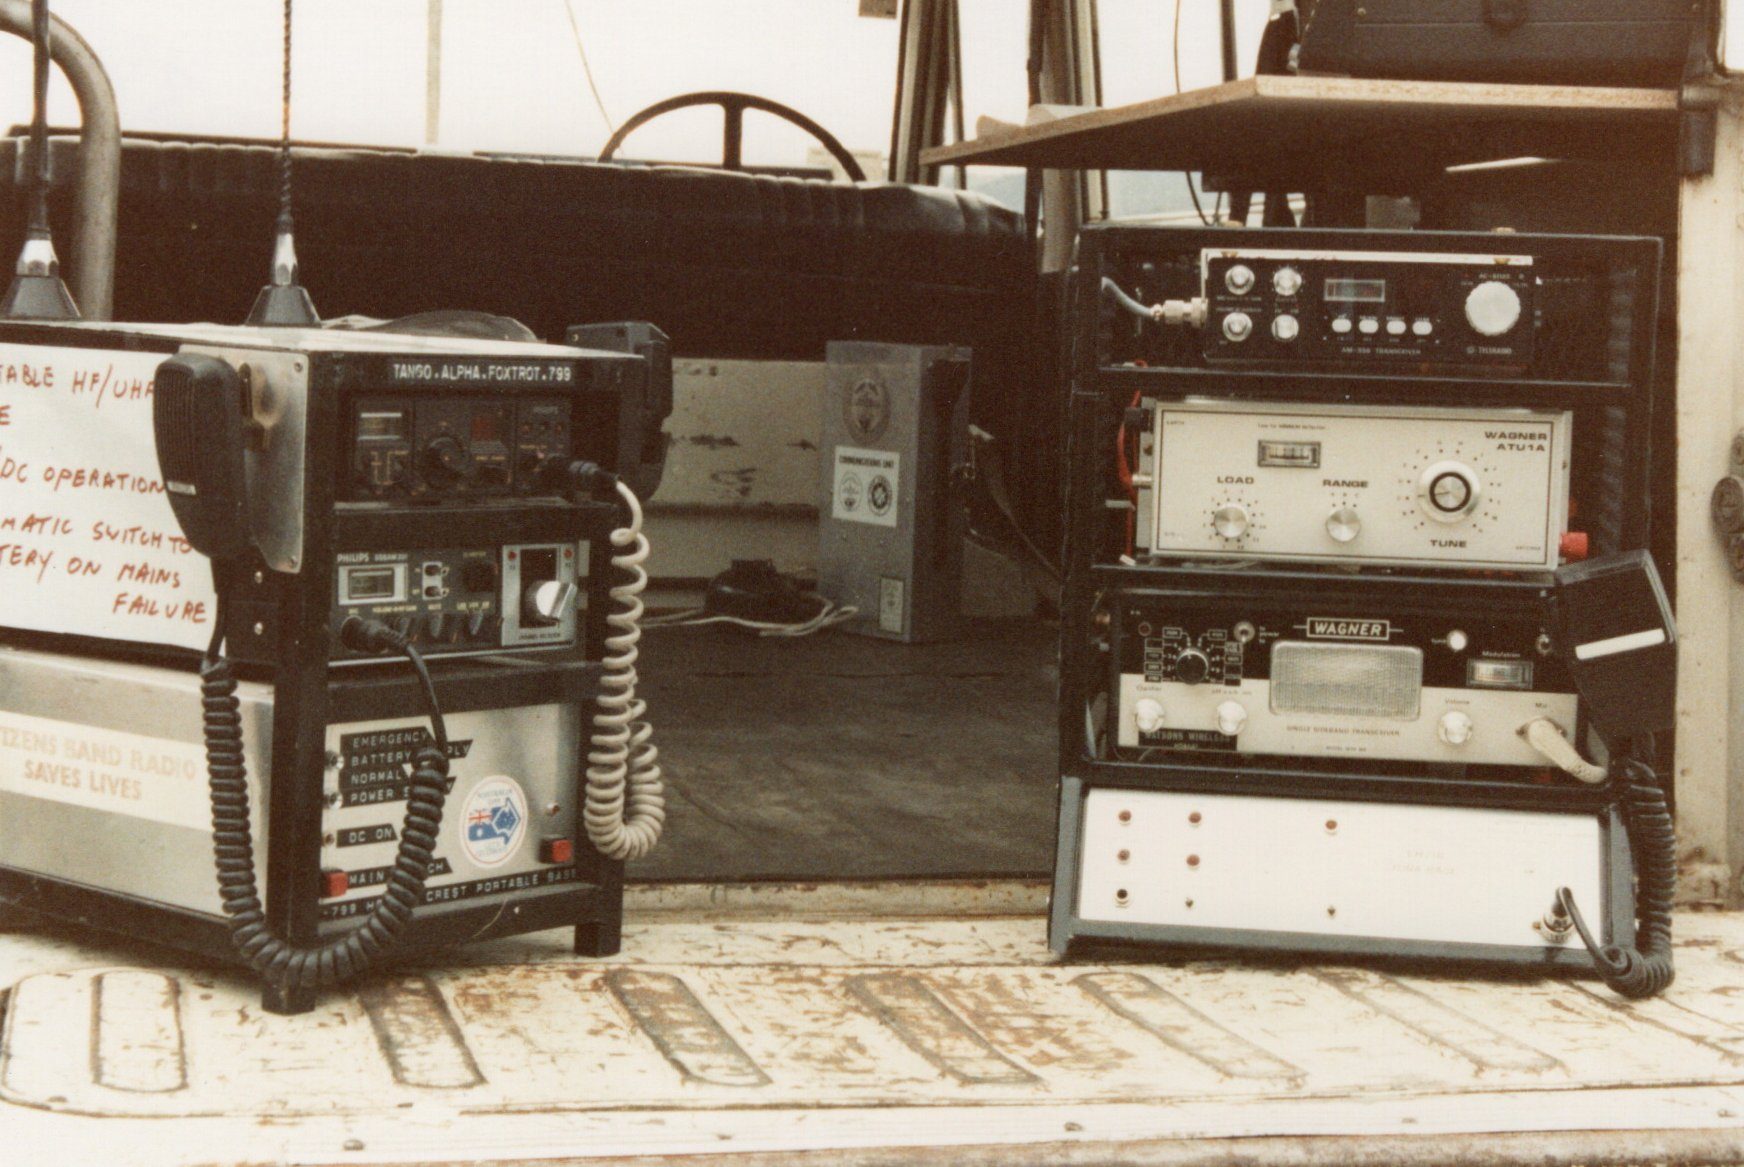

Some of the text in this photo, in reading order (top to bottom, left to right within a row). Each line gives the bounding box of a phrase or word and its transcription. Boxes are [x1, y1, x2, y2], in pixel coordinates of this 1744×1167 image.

[1484, 431, 1548, 442] WAGNER
[1496, 443, 1546, 452] ATU1A
[43, 466, 166, 493] OPERATION
[1217, 475, 1369, 489] LOAD RANGE
[92, 521, 162, 548] SWITCH
[168, 536, 193, 554] TO
[1430, 539, 1467, 548] TUNE
[337, 552, 369, 563] PHILIPS
[66, 556, 101, 576] ON
[117, 562, 182, 588] MAINS
[112, 592, 207, 624] FAILURE
[1314, 621, 1382, 637] WAGNER
[352, 731, 429, 748] EMERGENCY
[64, 738, 122, 767] BAND
[131, 749, 197, 780] RADIO
[351, 751, 411, 767] BATTERY
[24, 759, 142, 801] SAVES LIVES
[351, 770, 402, 785] NORMAL
[350, 788, 394, 803] POWER
[349, 827, 393, 844] DC ON
[476, 873, 539, 893] PORTABLE
